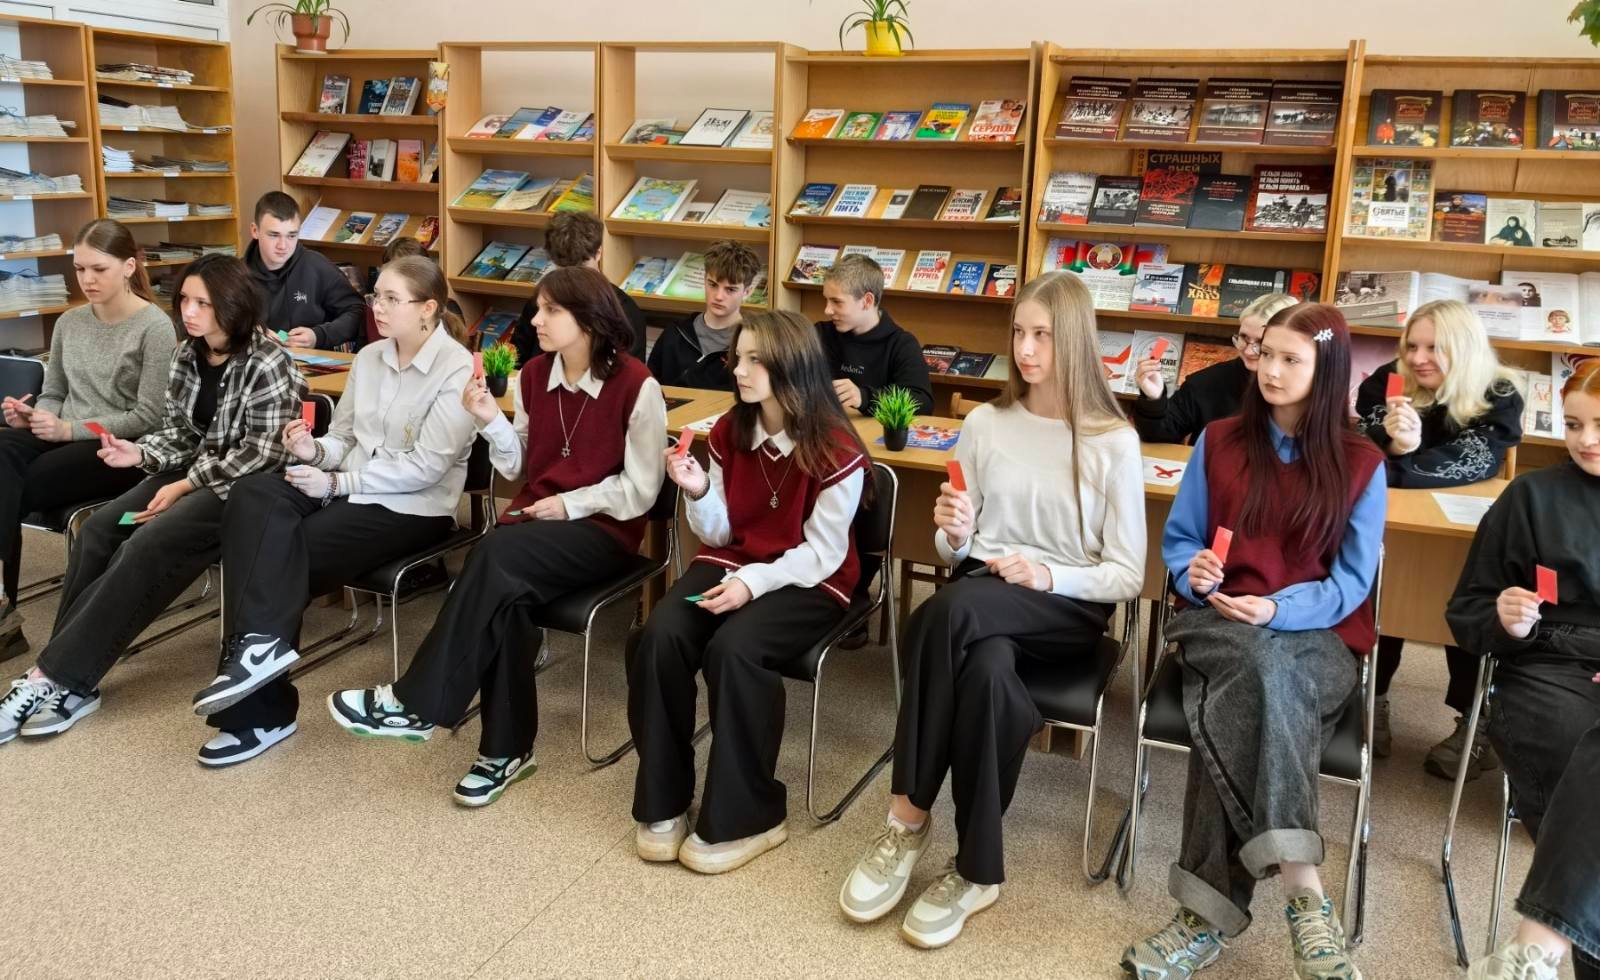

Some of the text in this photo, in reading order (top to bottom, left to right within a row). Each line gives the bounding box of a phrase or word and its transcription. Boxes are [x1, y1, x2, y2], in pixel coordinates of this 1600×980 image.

[1150, 152, 1221, 164] СТРАШНЫХ
[833, 205, 861, 213] ПИТЬ
[912, 272, 941, 280] КУРИТЬ
